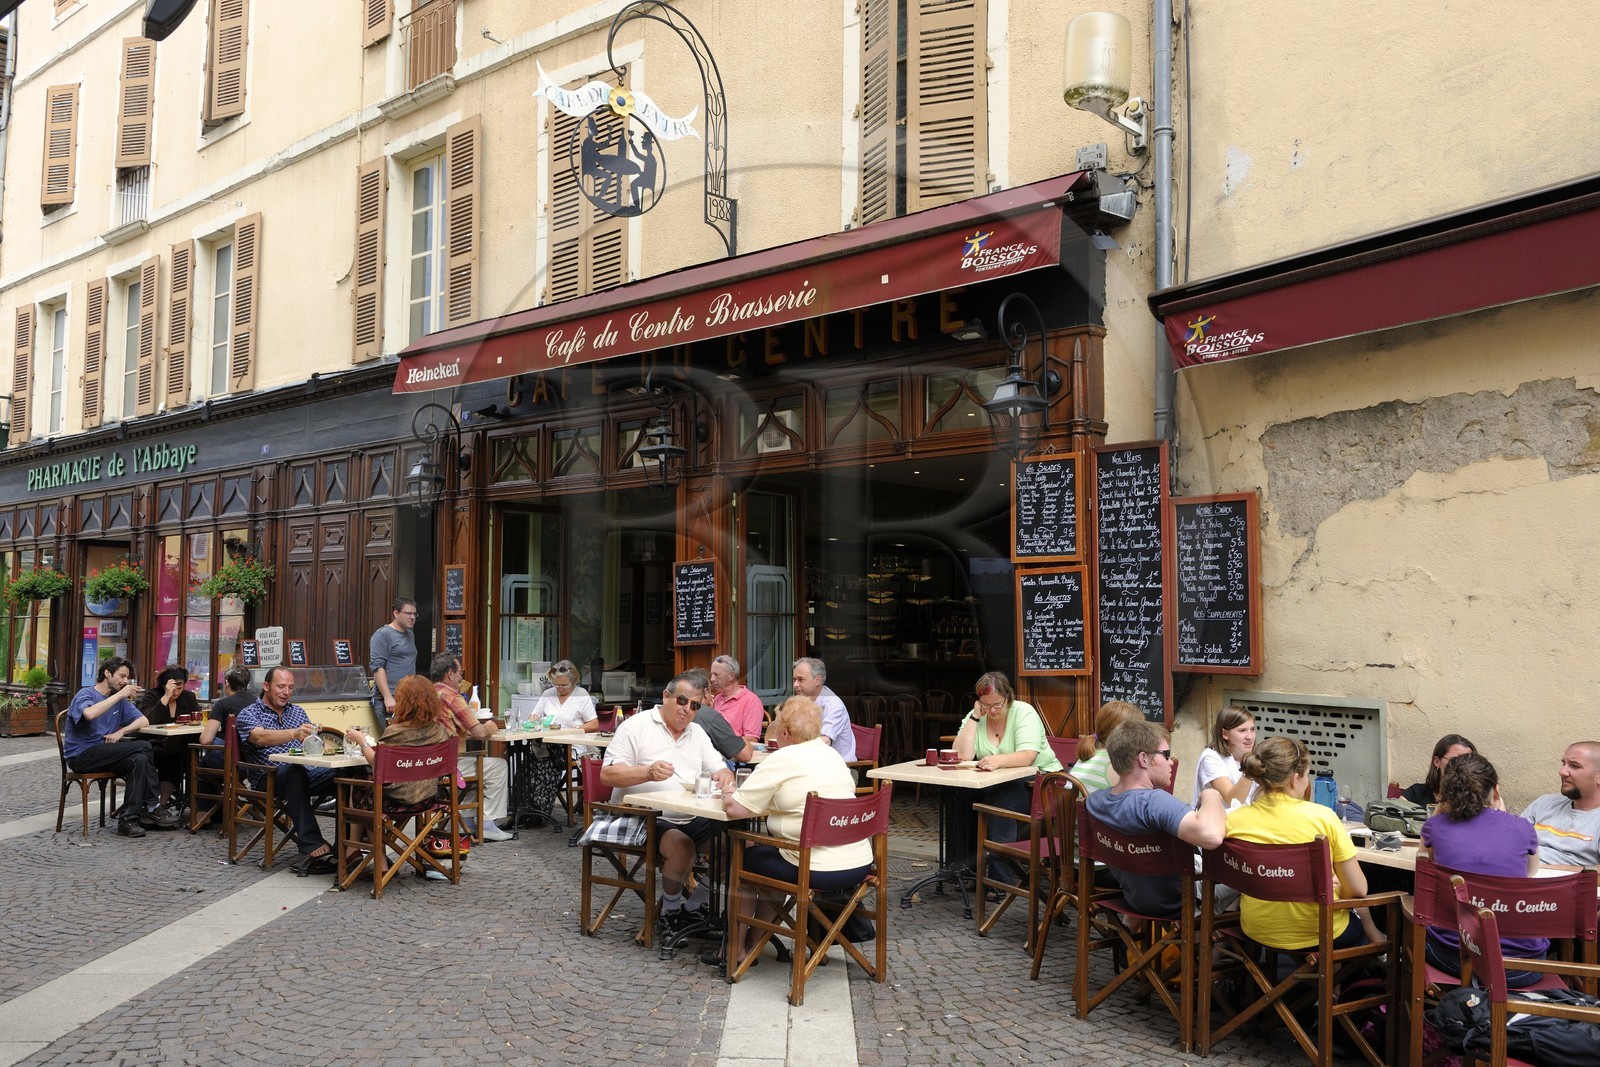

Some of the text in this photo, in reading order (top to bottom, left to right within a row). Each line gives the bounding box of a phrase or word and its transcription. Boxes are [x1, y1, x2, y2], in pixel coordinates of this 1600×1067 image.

[961, 245, 1038, 269] BOISSONS
[979, 243, 1024, 257] FRANCE
[545, 280, 817, 364] Café du Centre Brasserie
[1186, 333, 1265, 356] BOISSONS
[1204, 329, 1249, 344] FRANCE
[406, 362, 460, 385] Heineken
[27, 443, 197, 491] PHARMACIE de l'Abbaye
[396, 759, 413, 769] Café
[415, 758, 424, 767] du
[829, 815, 849, 827] Café
[850, 814, 859, 825] du
[1096, 831, 1162, 854] Café du Centre
[1223, 851, 1296, 878] Café du Centre
[1491, 899, 1558, 913] du Centre
